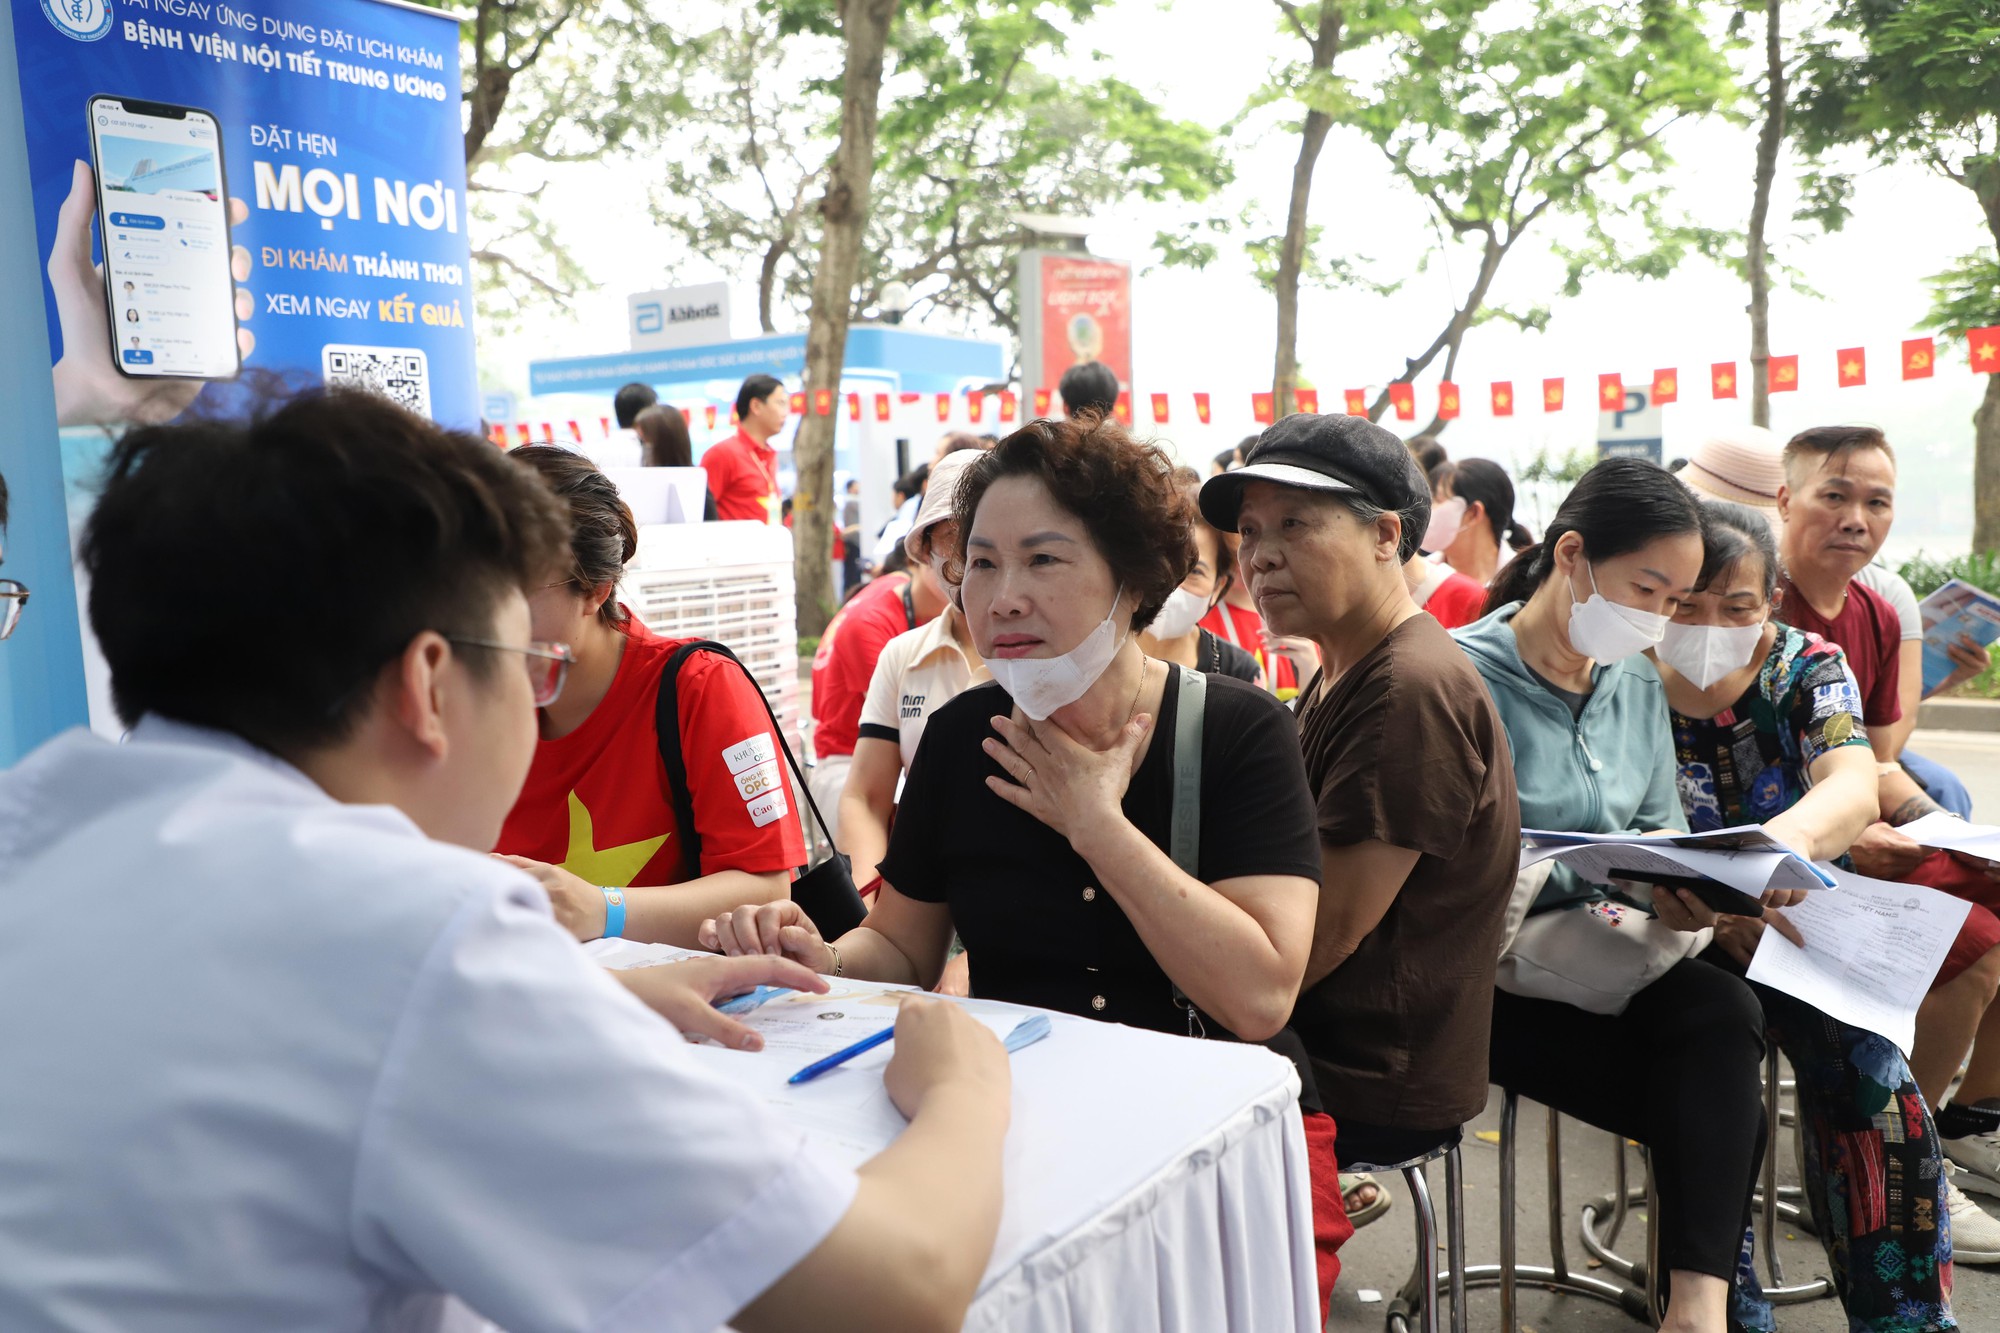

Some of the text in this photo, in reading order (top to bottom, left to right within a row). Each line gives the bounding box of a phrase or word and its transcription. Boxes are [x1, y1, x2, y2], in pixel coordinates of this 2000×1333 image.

[154, 0, 211, 20] NGAY
[216, 4, 258, 31] ỨNG
[263, 17, 317, 43] DỤNG
[320, 29, 354, 53] ĐẶT
[357, 37, 394, 59] LỊCH
[396, 46, 444, 71] KHÁM
[123, 18, 447, 102] BỆNH VIỆN NỘI TIẾT TRUNG ƯƠNG
[250, 124, 337, 158] ĐẶT HẸN
[253, 160, 361, 231] MỌI
[373, 176, 458, 234] NƠI
[261, 246, 463, 285] ĐI KHÁM THẢNH THƠI
[265, 292, 465, 328] XEM NGAY KẾT QUẢ
[667, 302, 721, 324] Abbott
[1615, 392, 1646, 428] P
[901, 707, 921, 718] nim
[902, 695, 925, 706] nim
[745, 777, 770, 795] OPC
[752, 804, 773, 818] Cao
